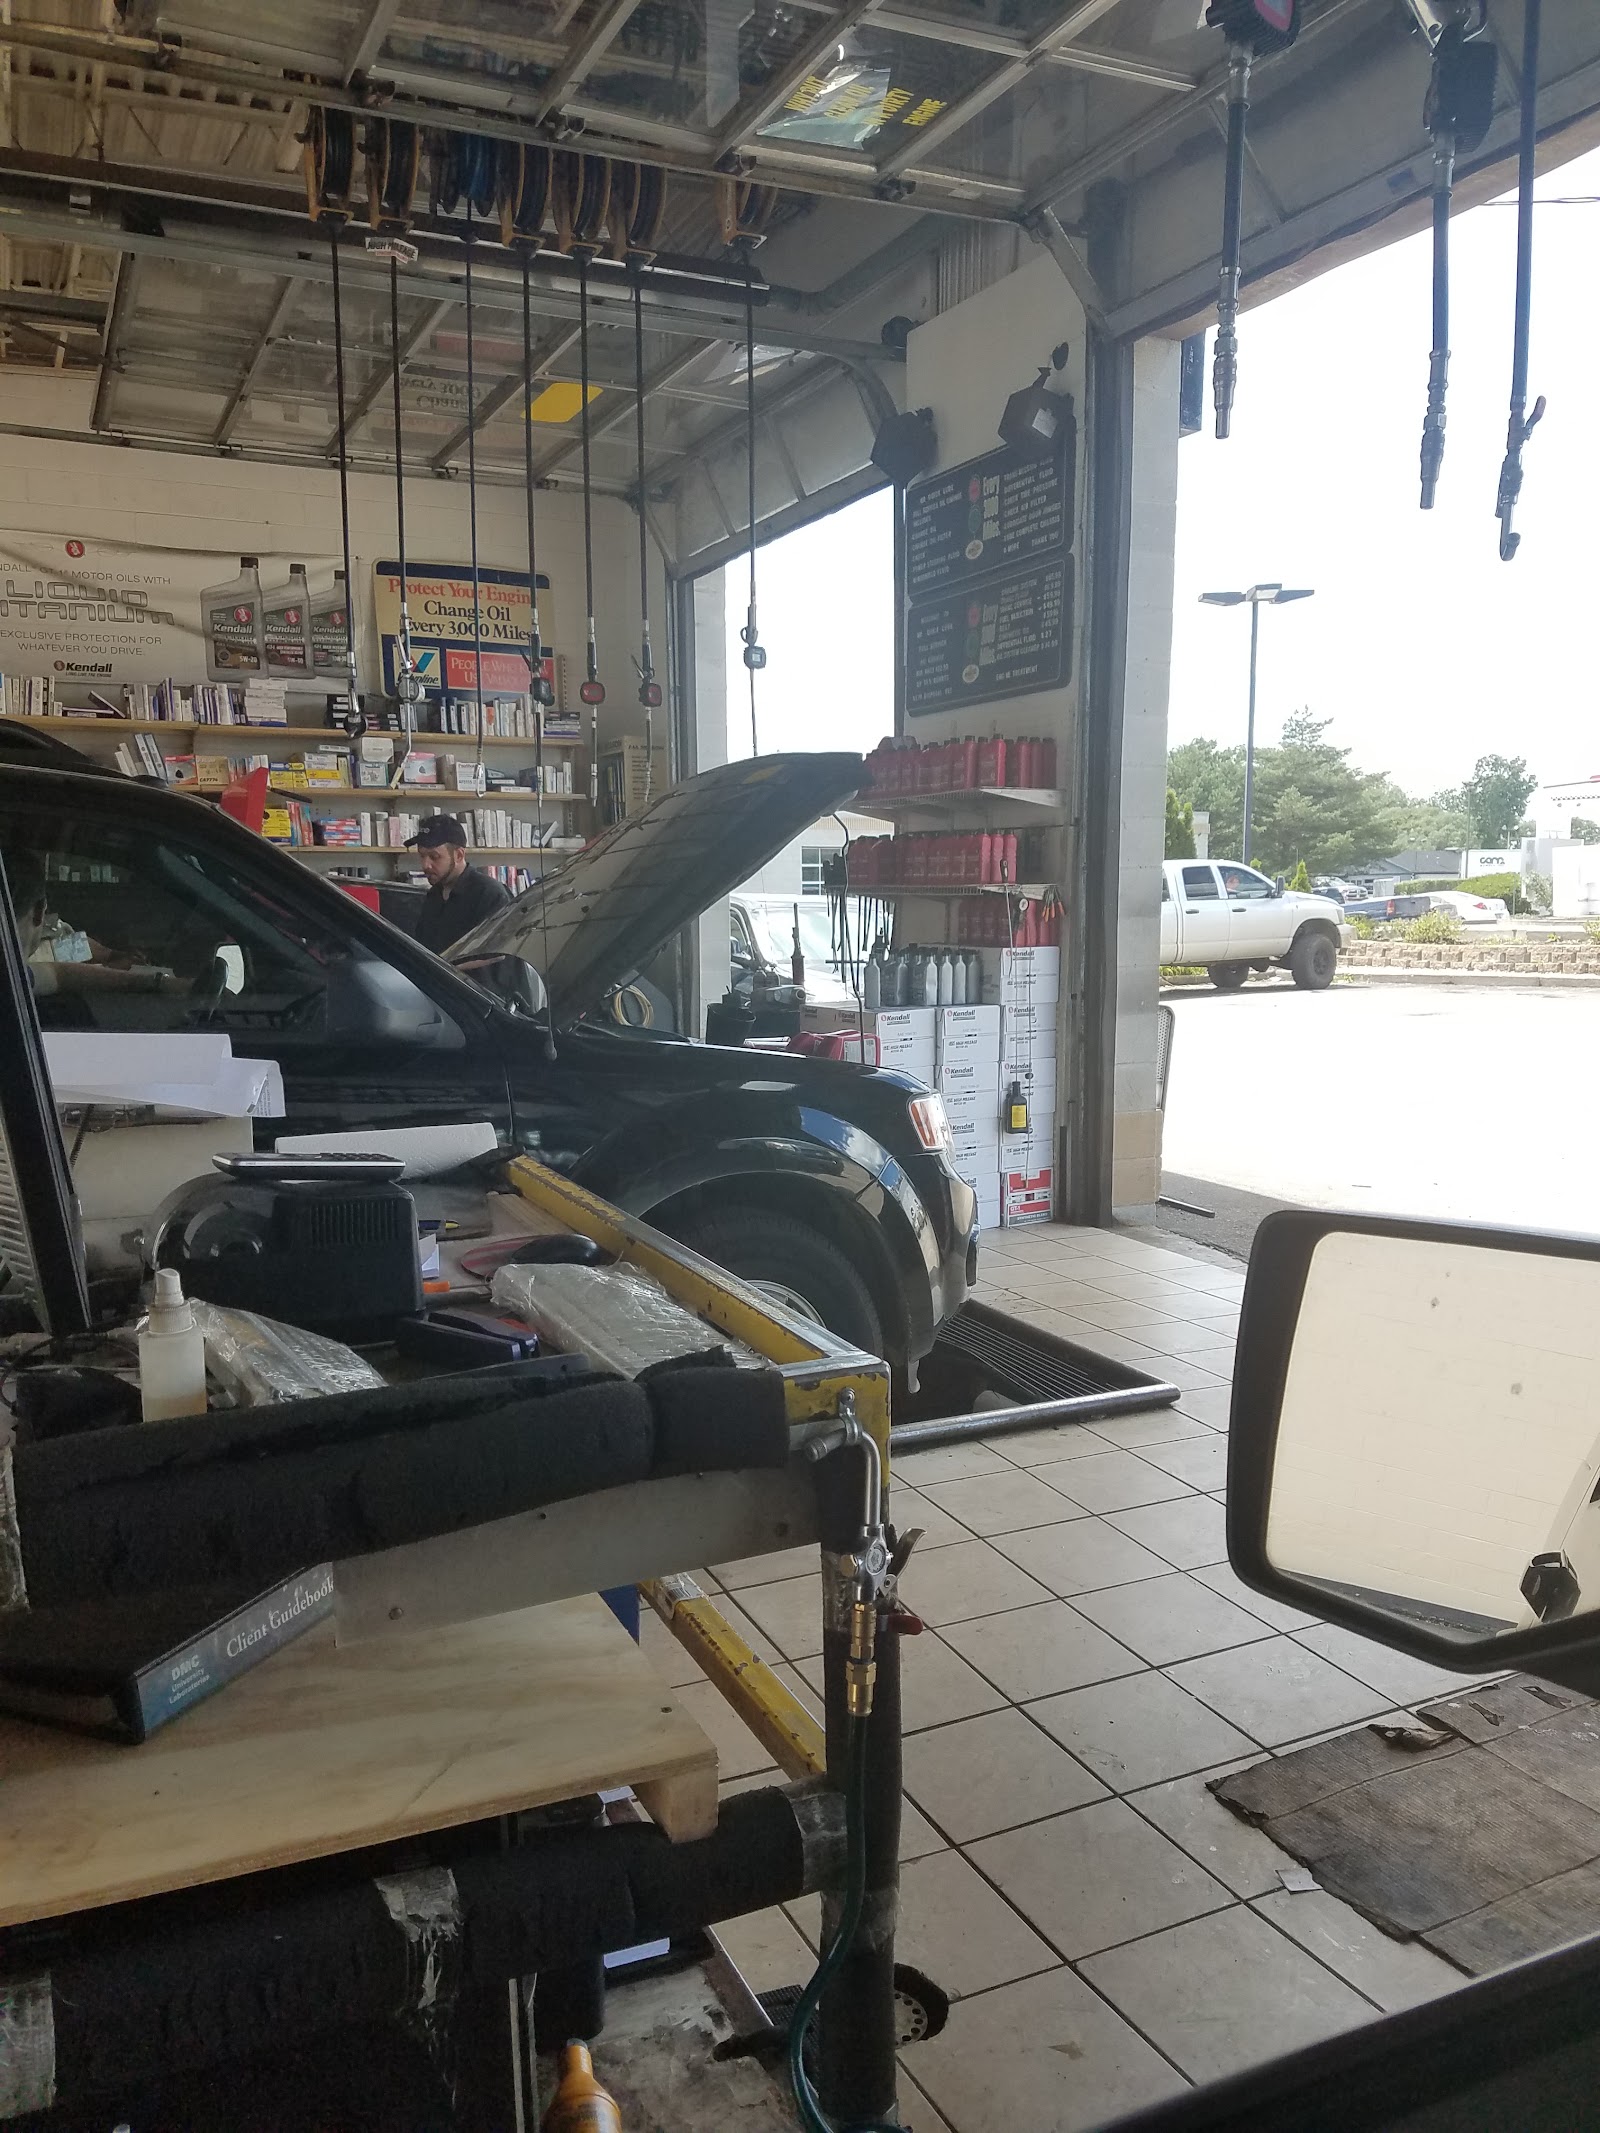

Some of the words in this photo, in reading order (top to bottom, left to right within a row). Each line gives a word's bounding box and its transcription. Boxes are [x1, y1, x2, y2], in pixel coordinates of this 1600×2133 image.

[902, 98, 947, 126] ENGINE
[72, 571, 112, 582] MOTOR
[116, 573, 141, 583] OILS
[143, 575, 171, 584] WITH
[6, 580, 148, 608] LIQUID
[486, 586, 532, 606] Engin
[0, 600, 175, 626] ITANIUM
[424, 600, 484, 621] Change
[487, 605, 512, 622] Oil
[213, 623, 253, 634] Kendall
[266, 624, 301, 634] Kendall
[313, 626, 346, 634] Kendall
[448, 620, 490, 638] 3,000
[0, 630, 61, 641] EXCLUSIVE
[66, 633, 140, 644] PROTECTION
[140, 637, 162, 645] FOR
[18, 643, 80, 654] WHATEVER
[84, 646, 107, 654] YOU
[66, 662, 113, 673] Kendall
[451, 657, 489, 671] PEOPE
[464, 671, 481, 684] US
[1012, 949, 1035, 957] Kendall
[953, 1009, 976, 1018] Kendall
[1013, 1006, 1036, 1014] Kendall
[887, 1013, 911, 1022] Kendall
[950, 1066, 974, 1075] Kendall
[952, 1122, 975, 1131] Kendall
[226, 1624, 268, 1658] Client
[269, 1575, 334, 1630] Guidebook
[172, 1667, 205, 1693] University
[169, 1674, 210, 1704] Laboratories
